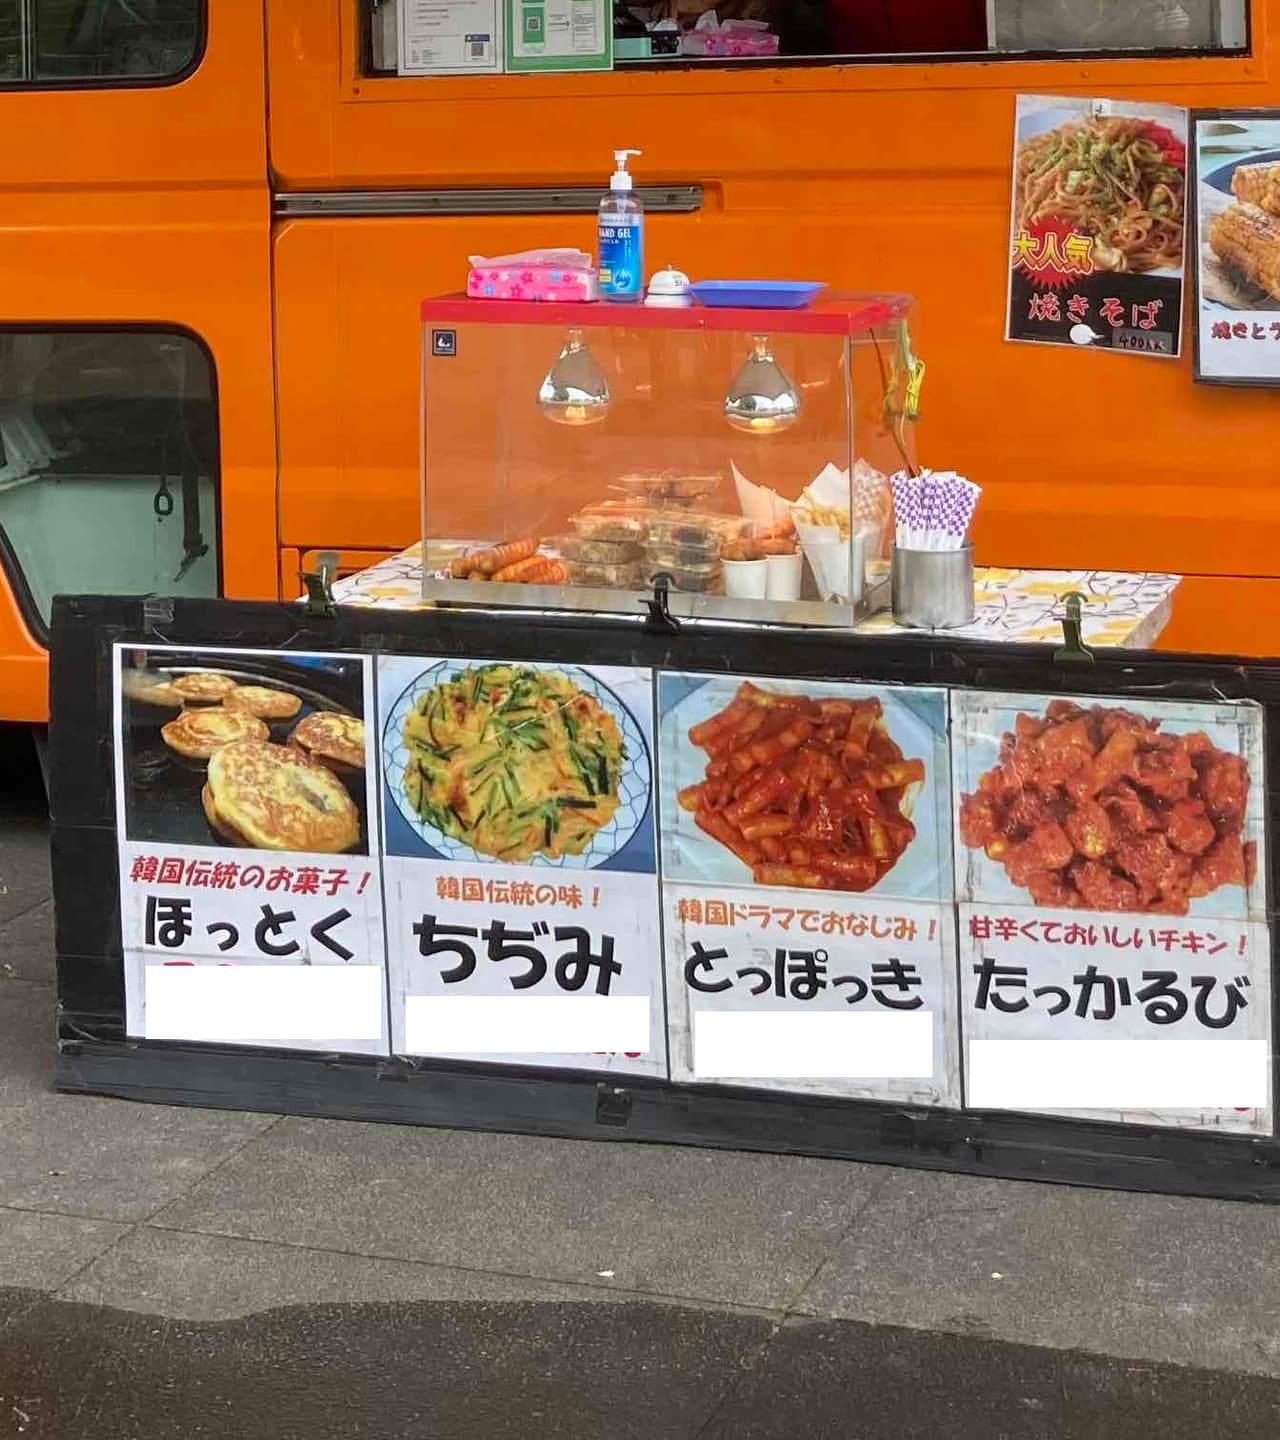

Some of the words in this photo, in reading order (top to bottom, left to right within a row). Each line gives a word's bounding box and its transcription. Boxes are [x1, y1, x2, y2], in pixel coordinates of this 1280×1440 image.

[617, 228, 631, 239] GEL
[1012, 229, 1095, 275] 大人気
[1028, 292, 1163, 329] 焼きそば
[130, 855, 373, 896] 韓国伝統のお菓子！
[436, 875, 601, 908] 韓国伝統の味！
[145, 895, 354, 961] ほっとく
[676, 898, 937, 941] 韓国ドラマでおなじみ！
[969, 915, 1248, 956] 甘辛くておいしいチキン！
[412, 914, 622, 996] ちぢみ
[683, 940, 924, 1010] とっぽっき
[973, 957, 1252, 1029] たっかるび
